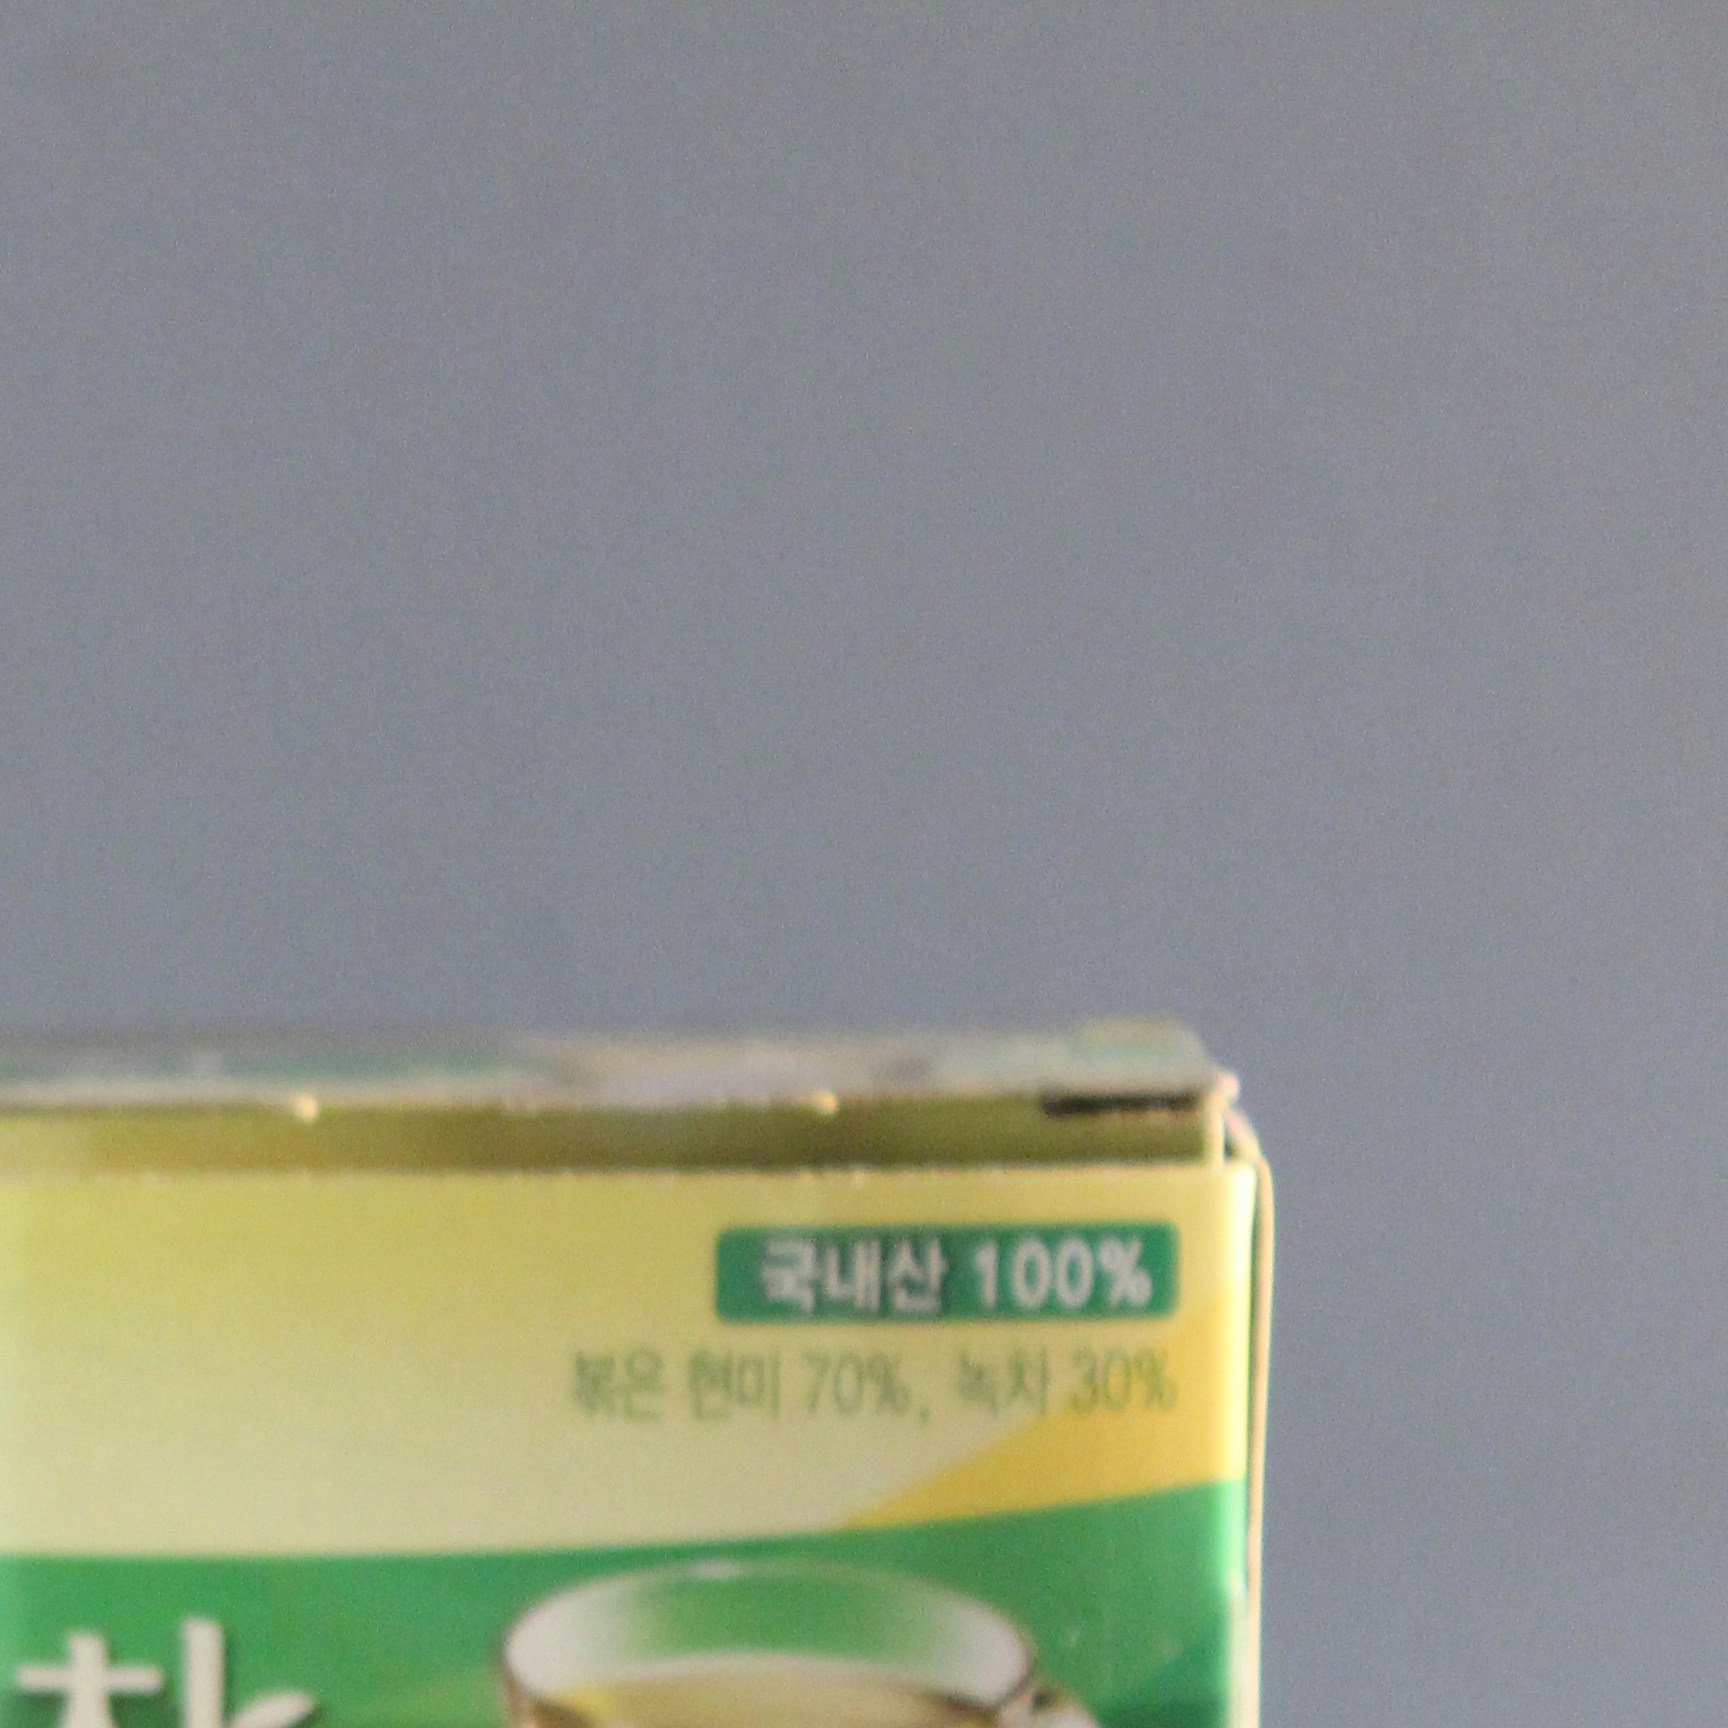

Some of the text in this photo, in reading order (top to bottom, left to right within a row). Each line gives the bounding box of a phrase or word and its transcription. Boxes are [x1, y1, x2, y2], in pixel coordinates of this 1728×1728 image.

[760, 1237, 1154, 1314] 국내산 100%
[572, 1346, 668, 1422] 볶은
[687, 1345, 782, 1422] 현미
[954, 1347, 1052, 1423] 녹차
[1069, 1346, 1178, 1415] 30%
